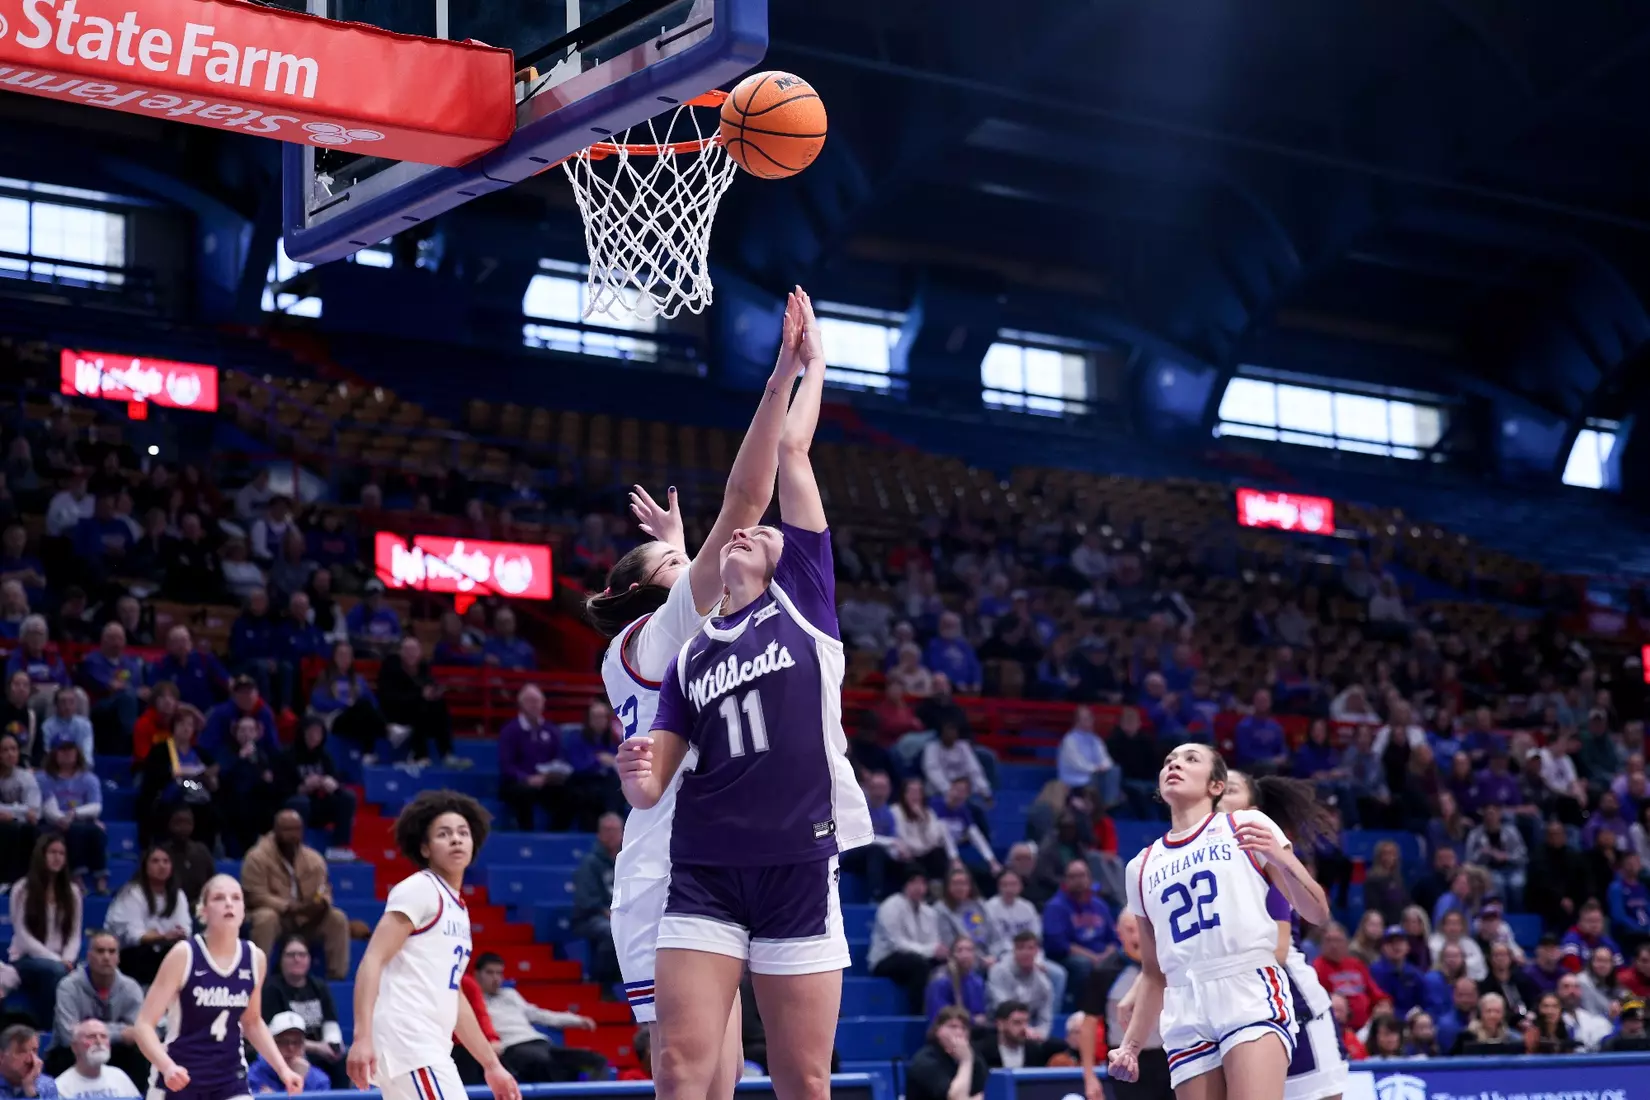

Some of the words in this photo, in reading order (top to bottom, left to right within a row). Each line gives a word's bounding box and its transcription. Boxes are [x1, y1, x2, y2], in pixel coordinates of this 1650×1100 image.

[688, 639, 795, 713] Wildcats
[613, 694, 638, 740] 2
[719, 689, 770, 758] 11
[1148, 844, 1231, 894] JAYHAWKS
[1161, 870, 1220, 943] 22
[449, 945, 471, 990] 2
[210, 1009, 229, 1041] 4
